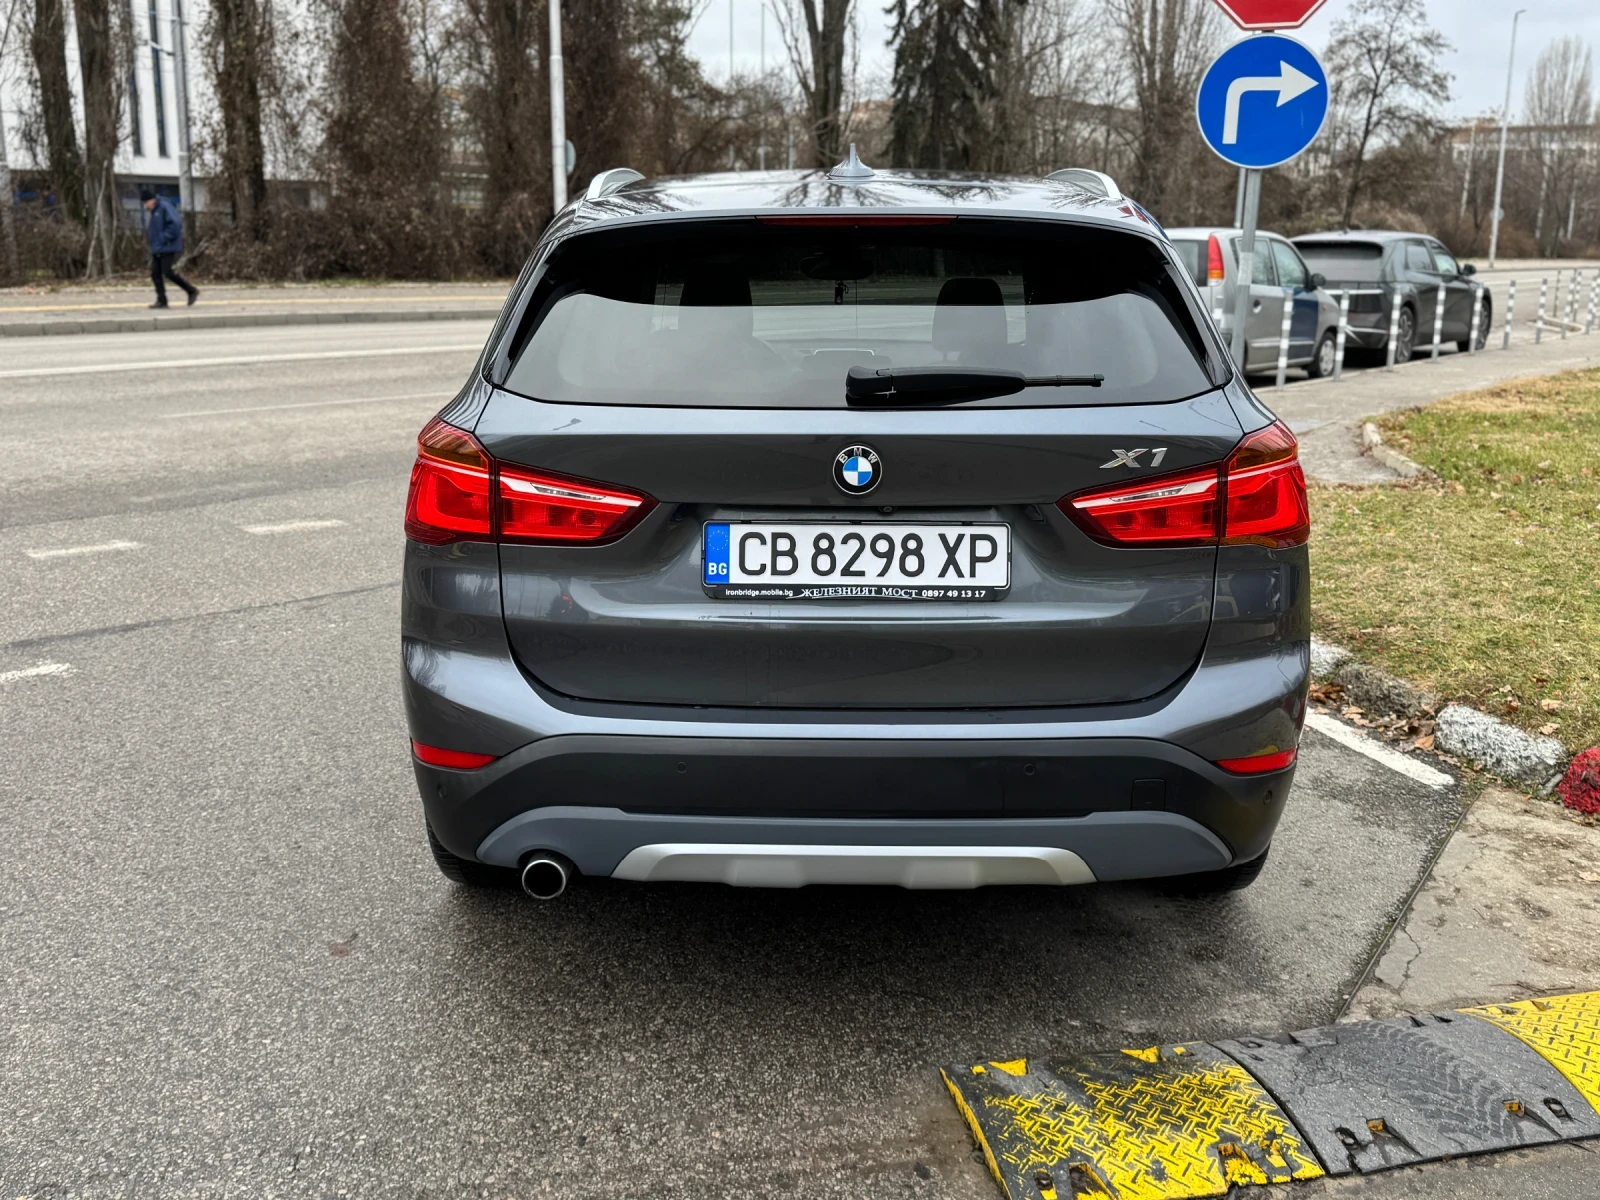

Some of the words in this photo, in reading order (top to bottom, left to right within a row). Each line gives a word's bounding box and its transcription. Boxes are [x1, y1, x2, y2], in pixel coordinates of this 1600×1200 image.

[839, 447, 878, 464] BMW
[1099, 447, 1168, 468] X1
[739, 531, 799, 576] CB
[811, 532, 925, 578] 8298
[938, 533, 998, 578] XP
[708, 562, 728, 576] BG
[801, 586, 878, 598] ЖЕЛЕЗНИЯТ
[882, 587, 918, 598] МОСТ
[922, 589, 945, 598] 0897
[947, 589, 959, 598] 49
[961, 589, 972, 598] 13
[975, 590, 986, 598] 17
